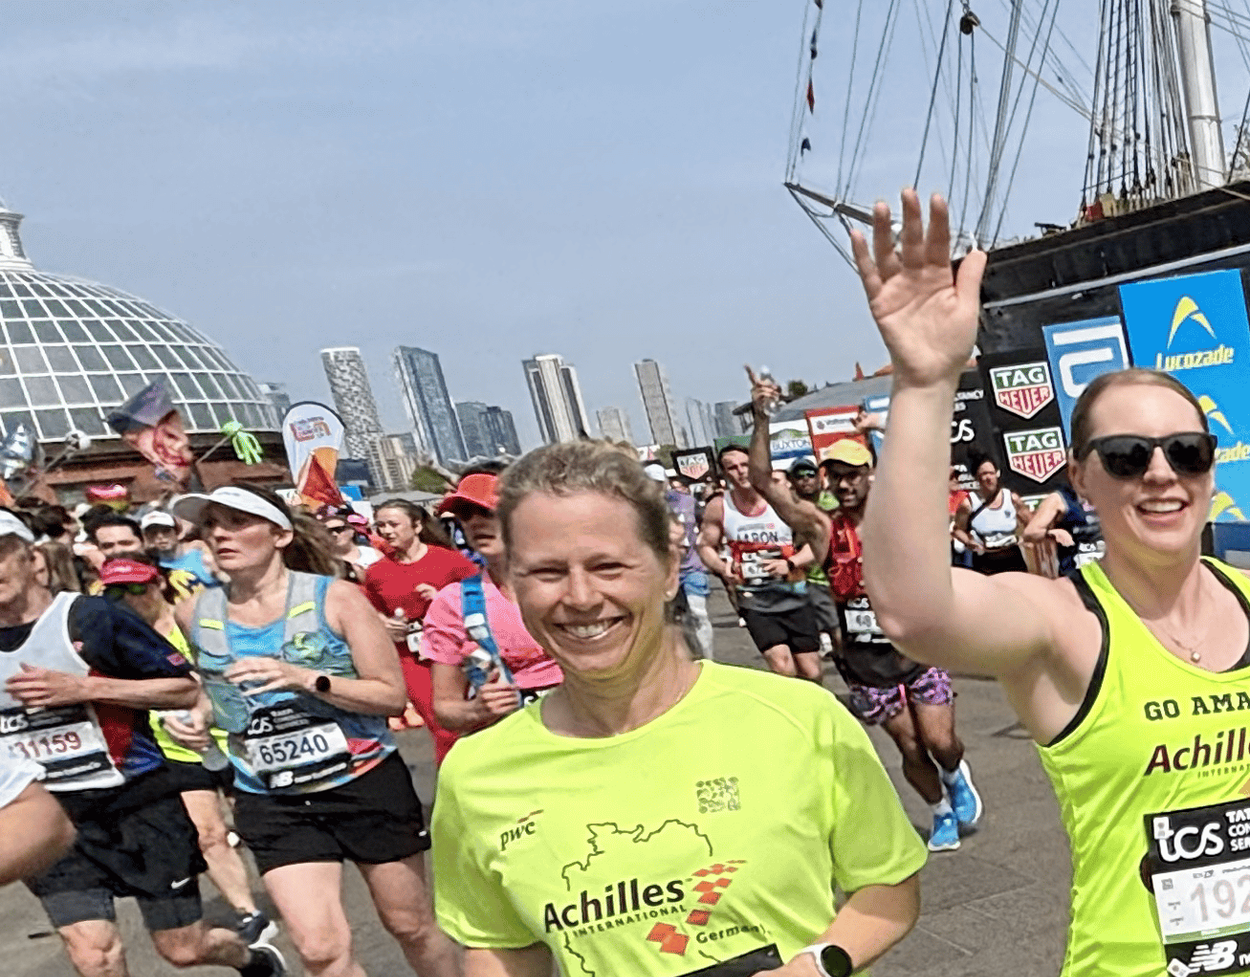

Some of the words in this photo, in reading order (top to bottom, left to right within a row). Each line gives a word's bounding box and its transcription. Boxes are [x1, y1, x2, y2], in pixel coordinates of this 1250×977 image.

[1155, 343, 1235, 372] Lucozade
[996, 367, 1045, 388] TAG
[999, 386, 1050, 415] HEUER
[1009, 432, 1058, 451] TAG
[1012, 450, 1064, 479] HEUER
[1144, 699, 1181, 722] GO
[259, 734, 329, 765] 65240
[500, 821, 536, 851] pwc
[544, 878, 685, 934] Achilles
[573, 904, 687, 938] INTERNATIONAL
